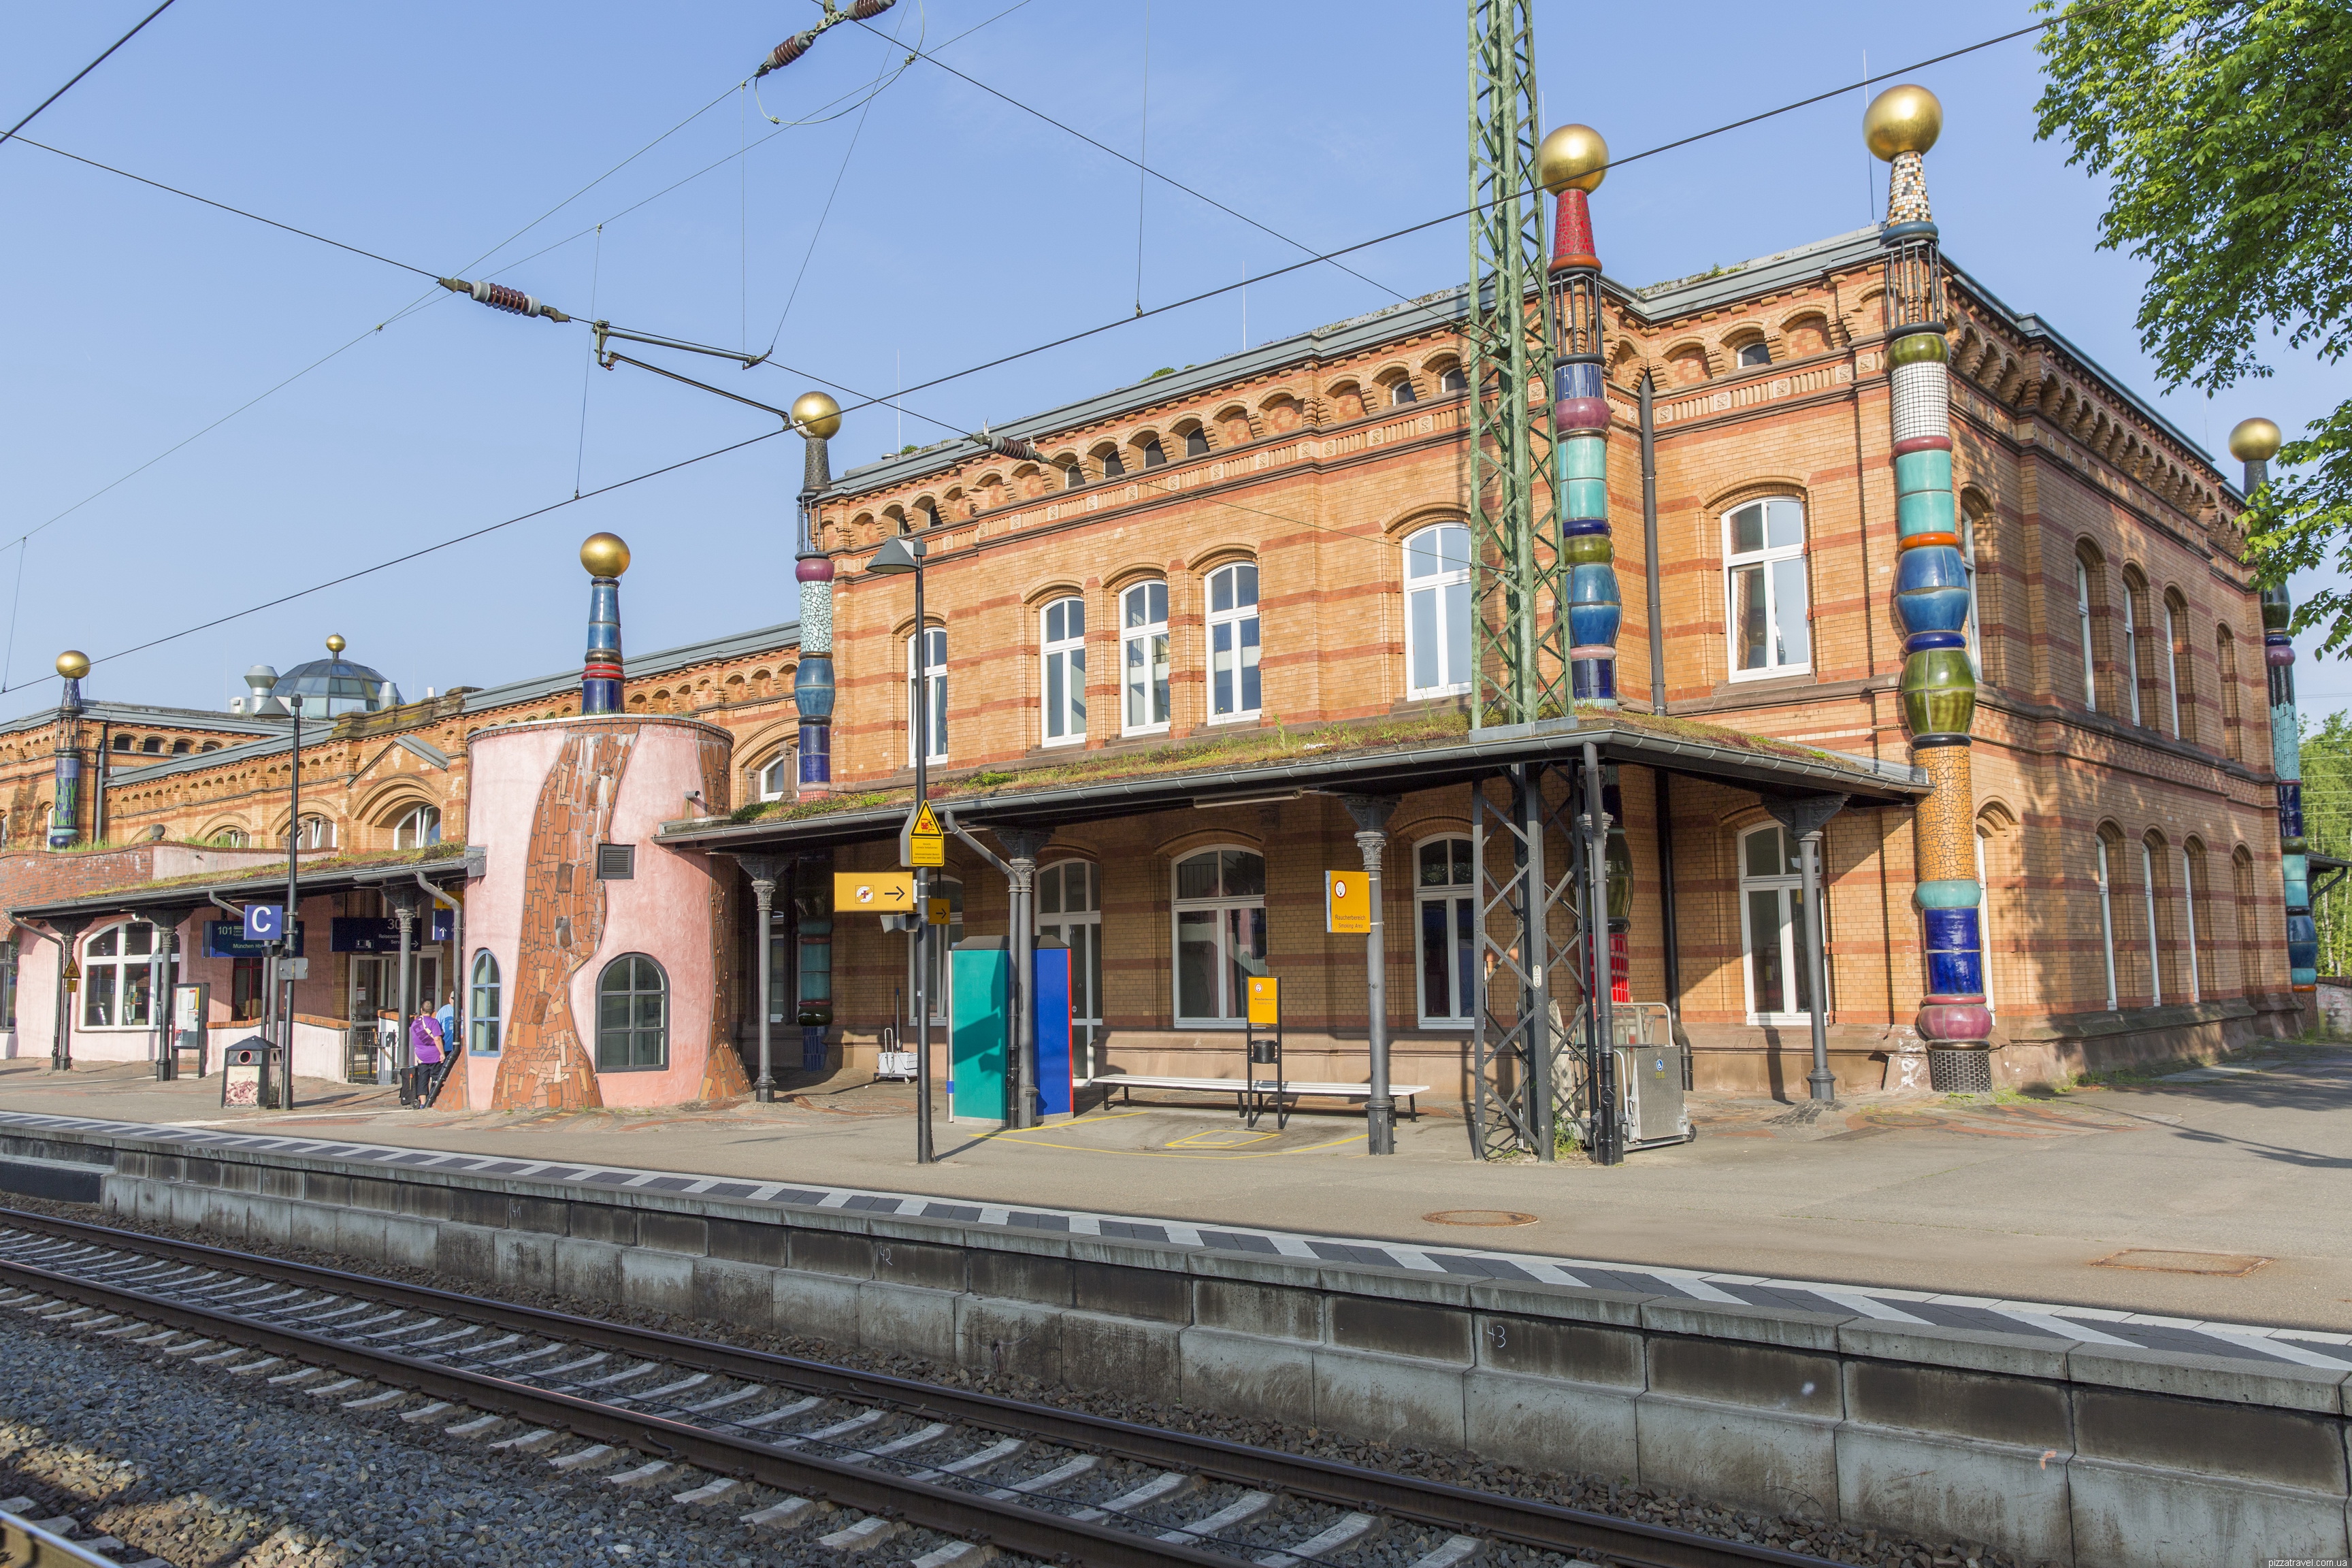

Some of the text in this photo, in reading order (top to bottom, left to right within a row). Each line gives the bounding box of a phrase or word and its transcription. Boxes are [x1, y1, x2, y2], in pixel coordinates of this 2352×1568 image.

[217, 926, 232, 935] 101
[252, 906, 272, 933] C
[876, 1245, 893, 1266] 142
[1480, 1321, 1506, 1348] 143
